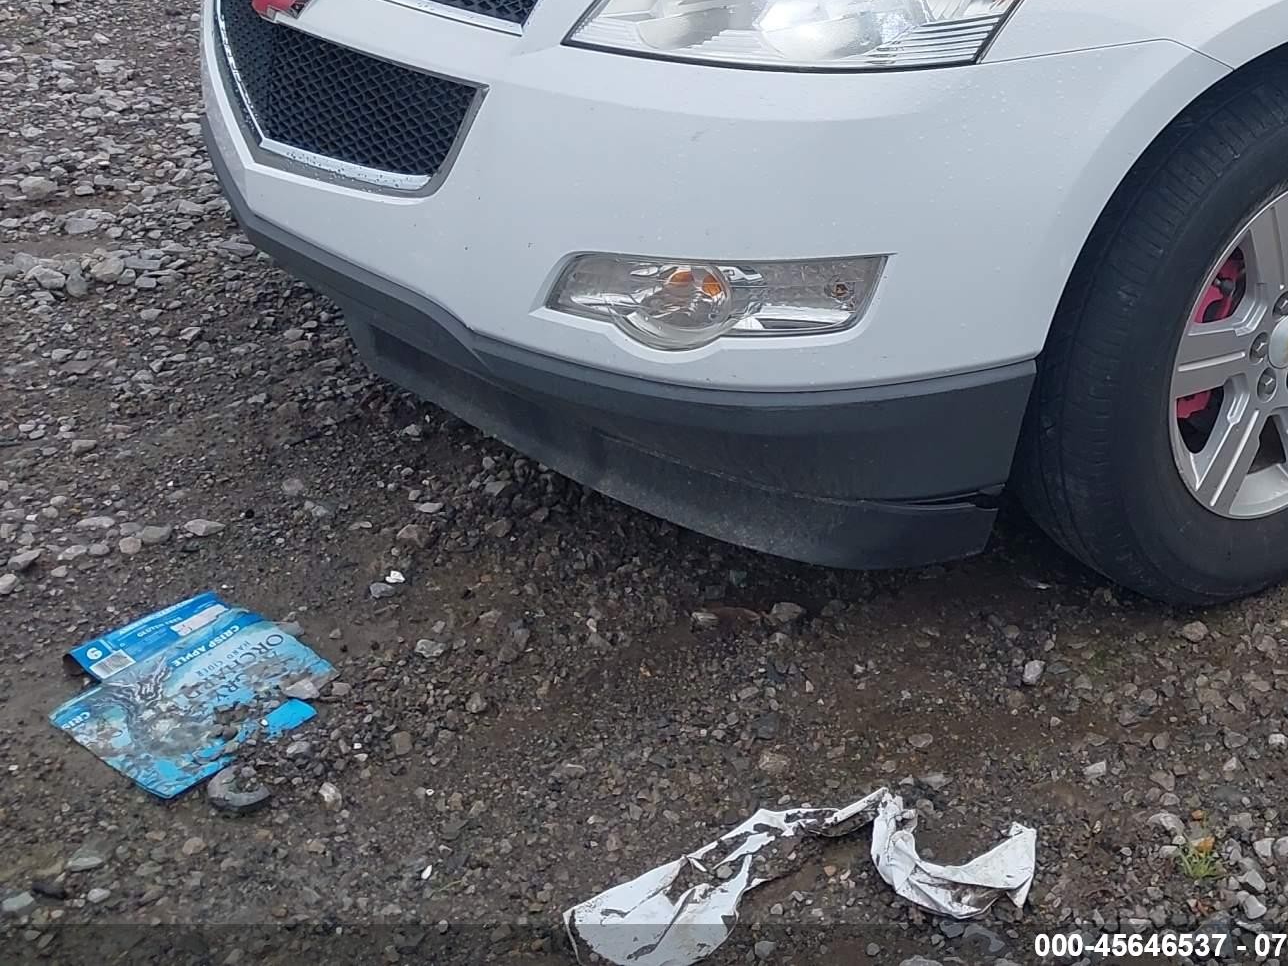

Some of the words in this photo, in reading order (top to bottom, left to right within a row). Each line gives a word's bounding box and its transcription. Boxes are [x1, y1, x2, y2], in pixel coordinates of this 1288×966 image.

[208, 625, 240, 648] CRISP
[171, 645, 206, 667] APPLE
[224, 640, 251, 660] HARD
[195, 659, 224, 677] CIDER
